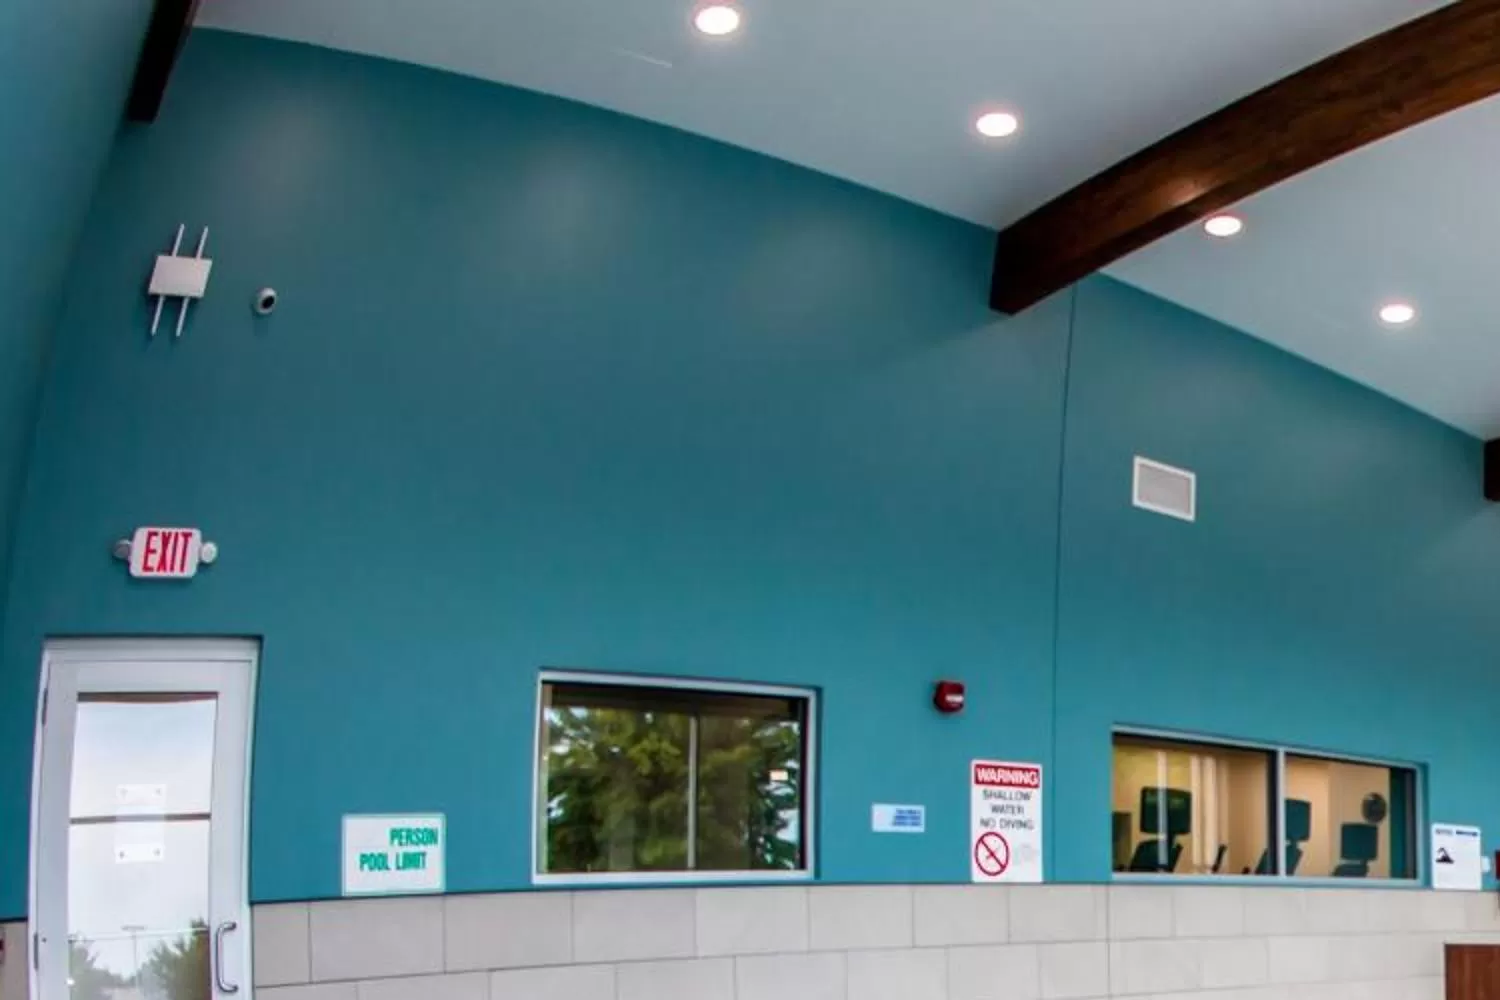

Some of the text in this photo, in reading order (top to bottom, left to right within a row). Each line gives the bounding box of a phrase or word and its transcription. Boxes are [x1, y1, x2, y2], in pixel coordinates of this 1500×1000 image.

[142, 531, 193, 573] EXIT
[976, 767, 1039, 787] WARNING
[982, 788, 1033, 802] SHALLOW
[990, 803, 1025, 816] WATER
[980, 817, 1034, 831] NO DIVING
[389, 827, 439, 846] PERSON
[359, 851, 427, 871] POOL LIMIT
